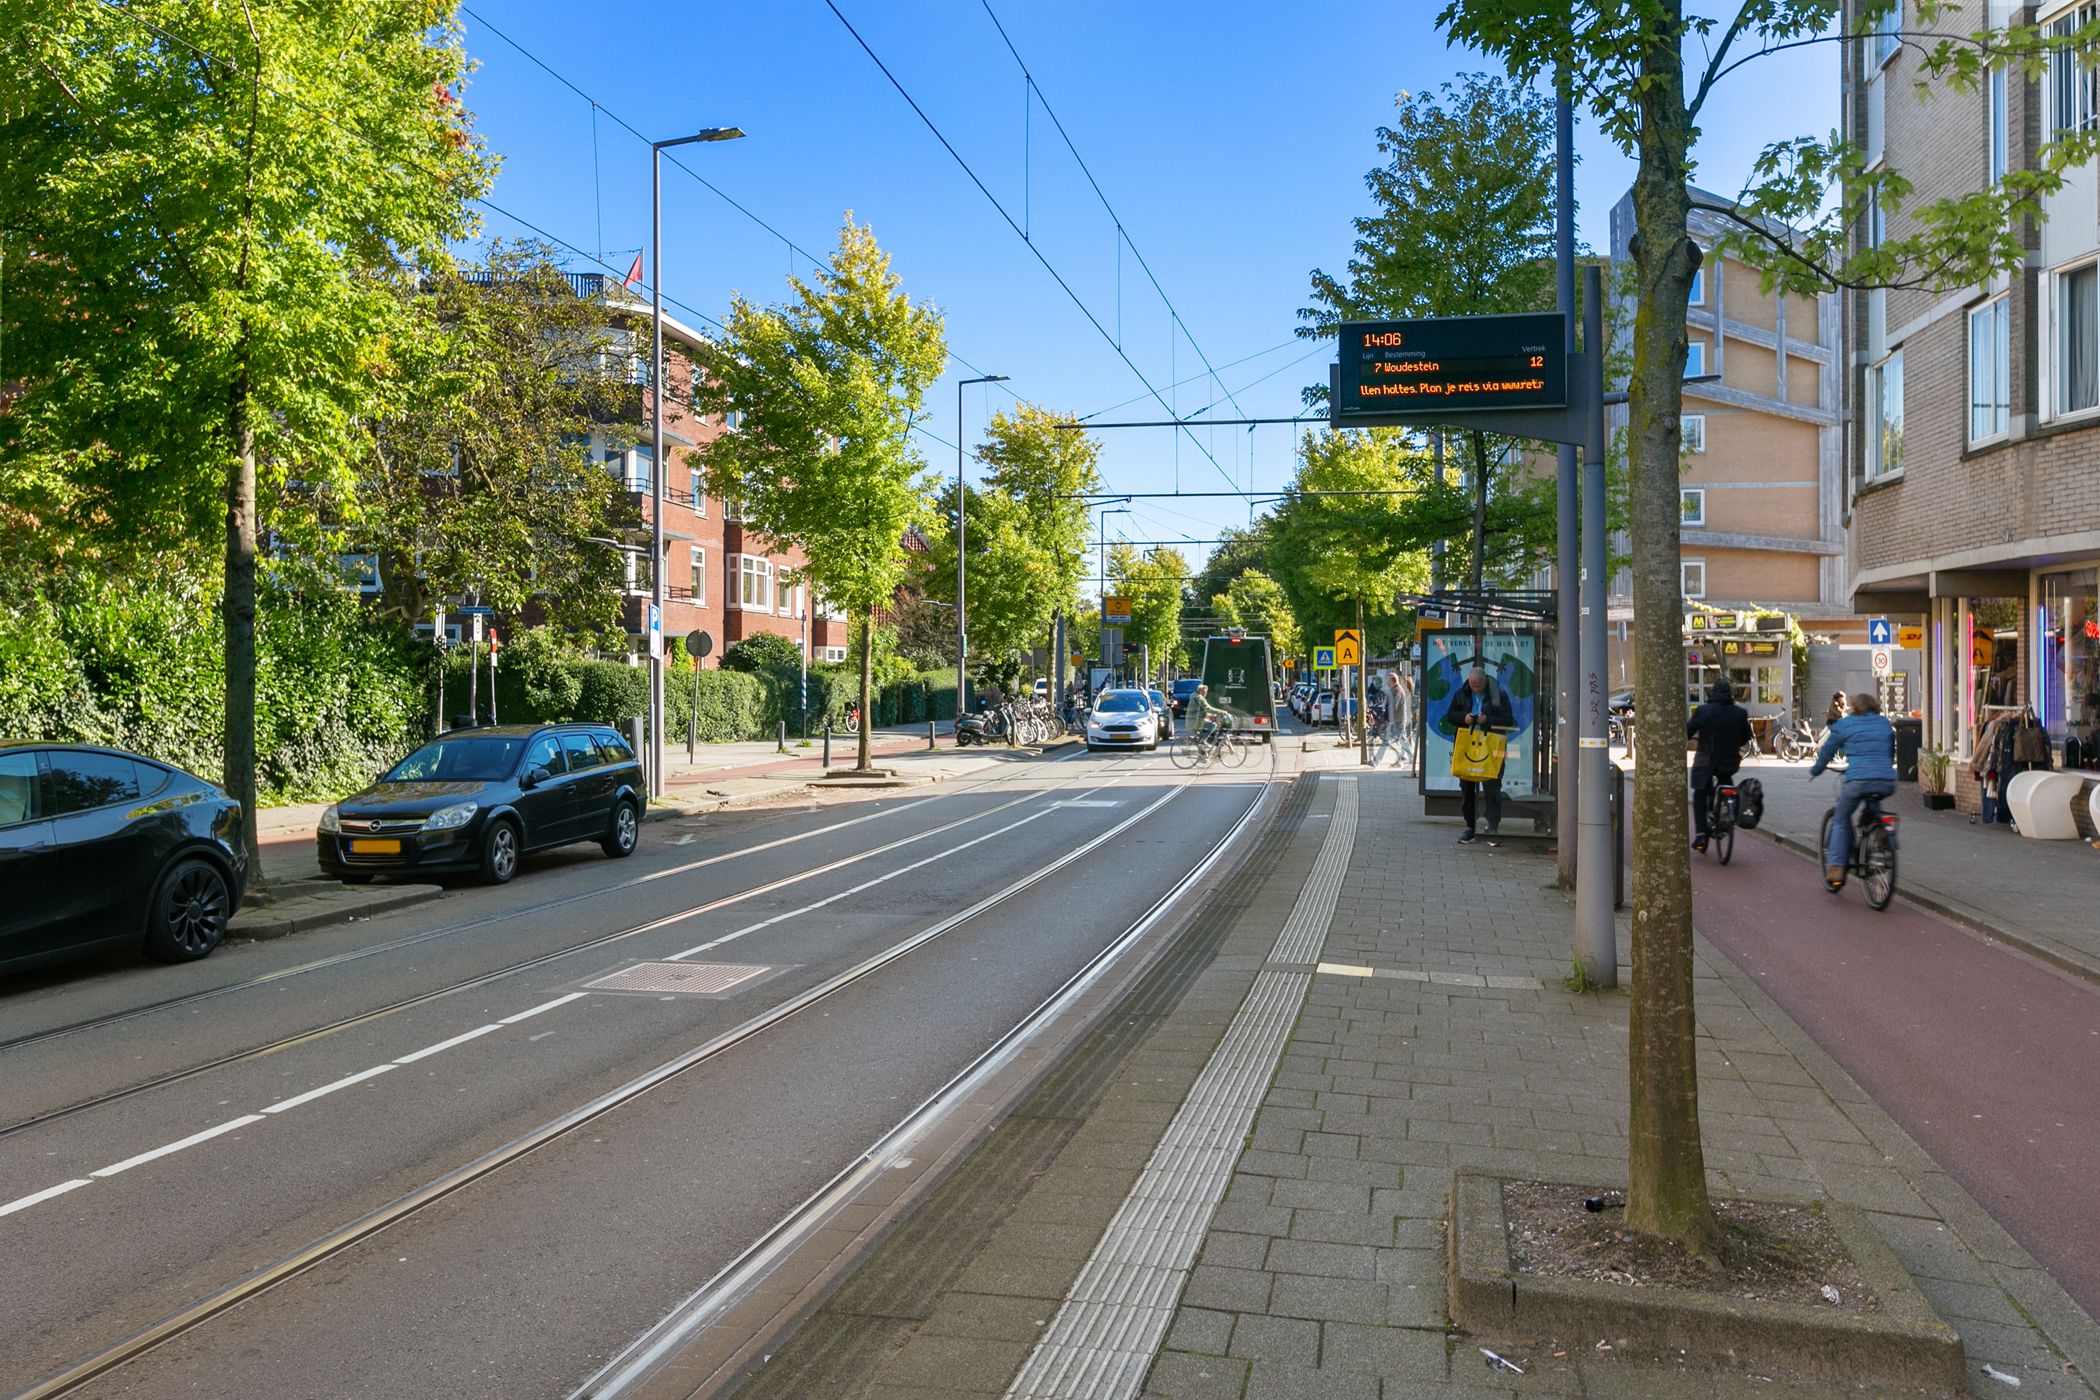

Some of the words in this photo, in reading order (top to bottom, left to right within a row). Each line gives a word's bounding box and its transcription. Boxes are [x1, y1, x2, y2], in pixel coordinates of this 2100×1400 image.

[1364, 332, 1402, 347] 14:06
[1384, 351, 1426, 360] Bestemming
[1374, 362, 1382, 374] 7
[1384, 361, 1440, 373] Woudestein
[1530, 355, 1544, 367] 12
[1383, 383, 1418, 395] haltes.
[1419, 382, 1442, 394] Plan
[1444, 382, 1456, 396] je
[1457, 381, 1480, 392] reis
[1482, 381, 1499, 391] via
[1343, 648, 1353, 659] A
